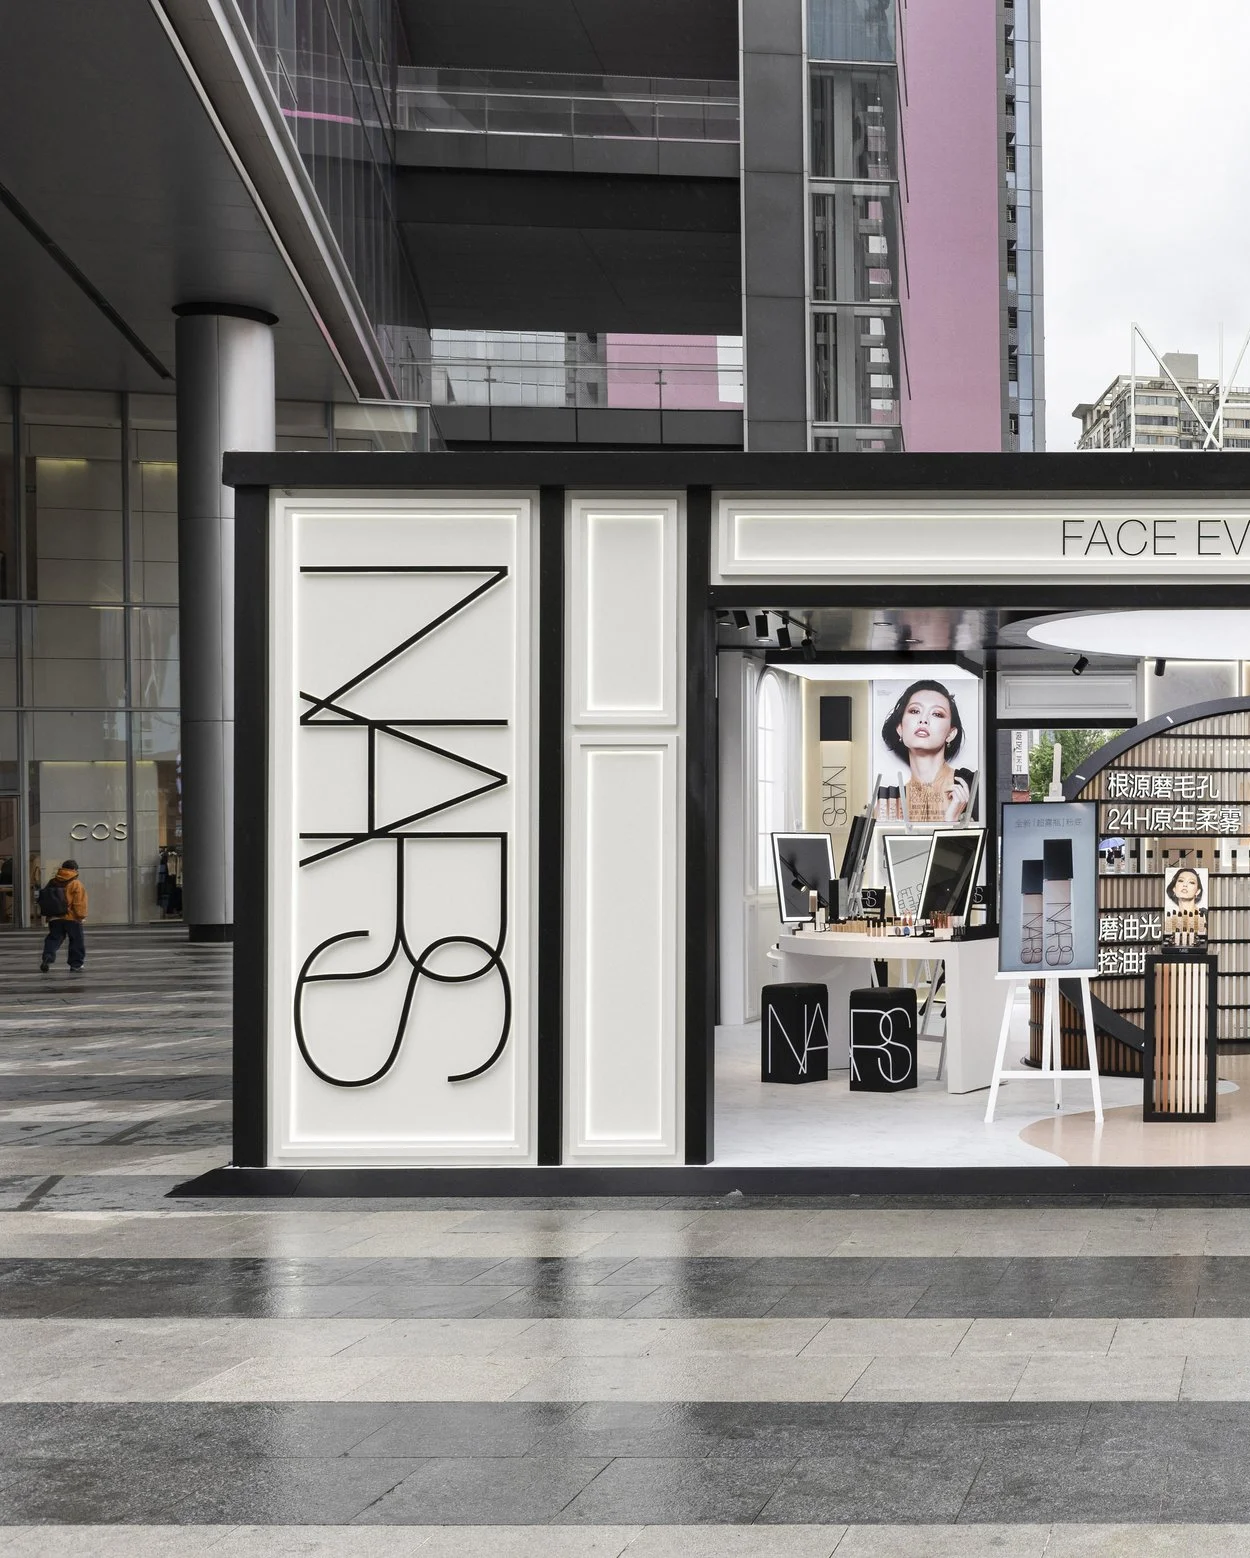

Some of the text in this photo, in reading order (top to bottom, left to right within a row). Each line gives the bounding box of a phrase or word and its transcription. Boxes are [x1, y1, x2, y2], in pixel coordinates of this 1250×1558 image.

[1062, 518, 1178, 556] FACE
[822, 766, 848, 827] NARS
[1107, 772, 1220, 799] 根源磨毛孔
[70, 822, 128, 841] COS
[294, 566, 511, 1088] NARS
[1107, 806, 1242, 833] 24H原生柔雾
[1020, 912, 1044, 965] NARS
[1045, 902, 1075, 967] NARS
[1098, 914, 1162, 941] 磨油光
